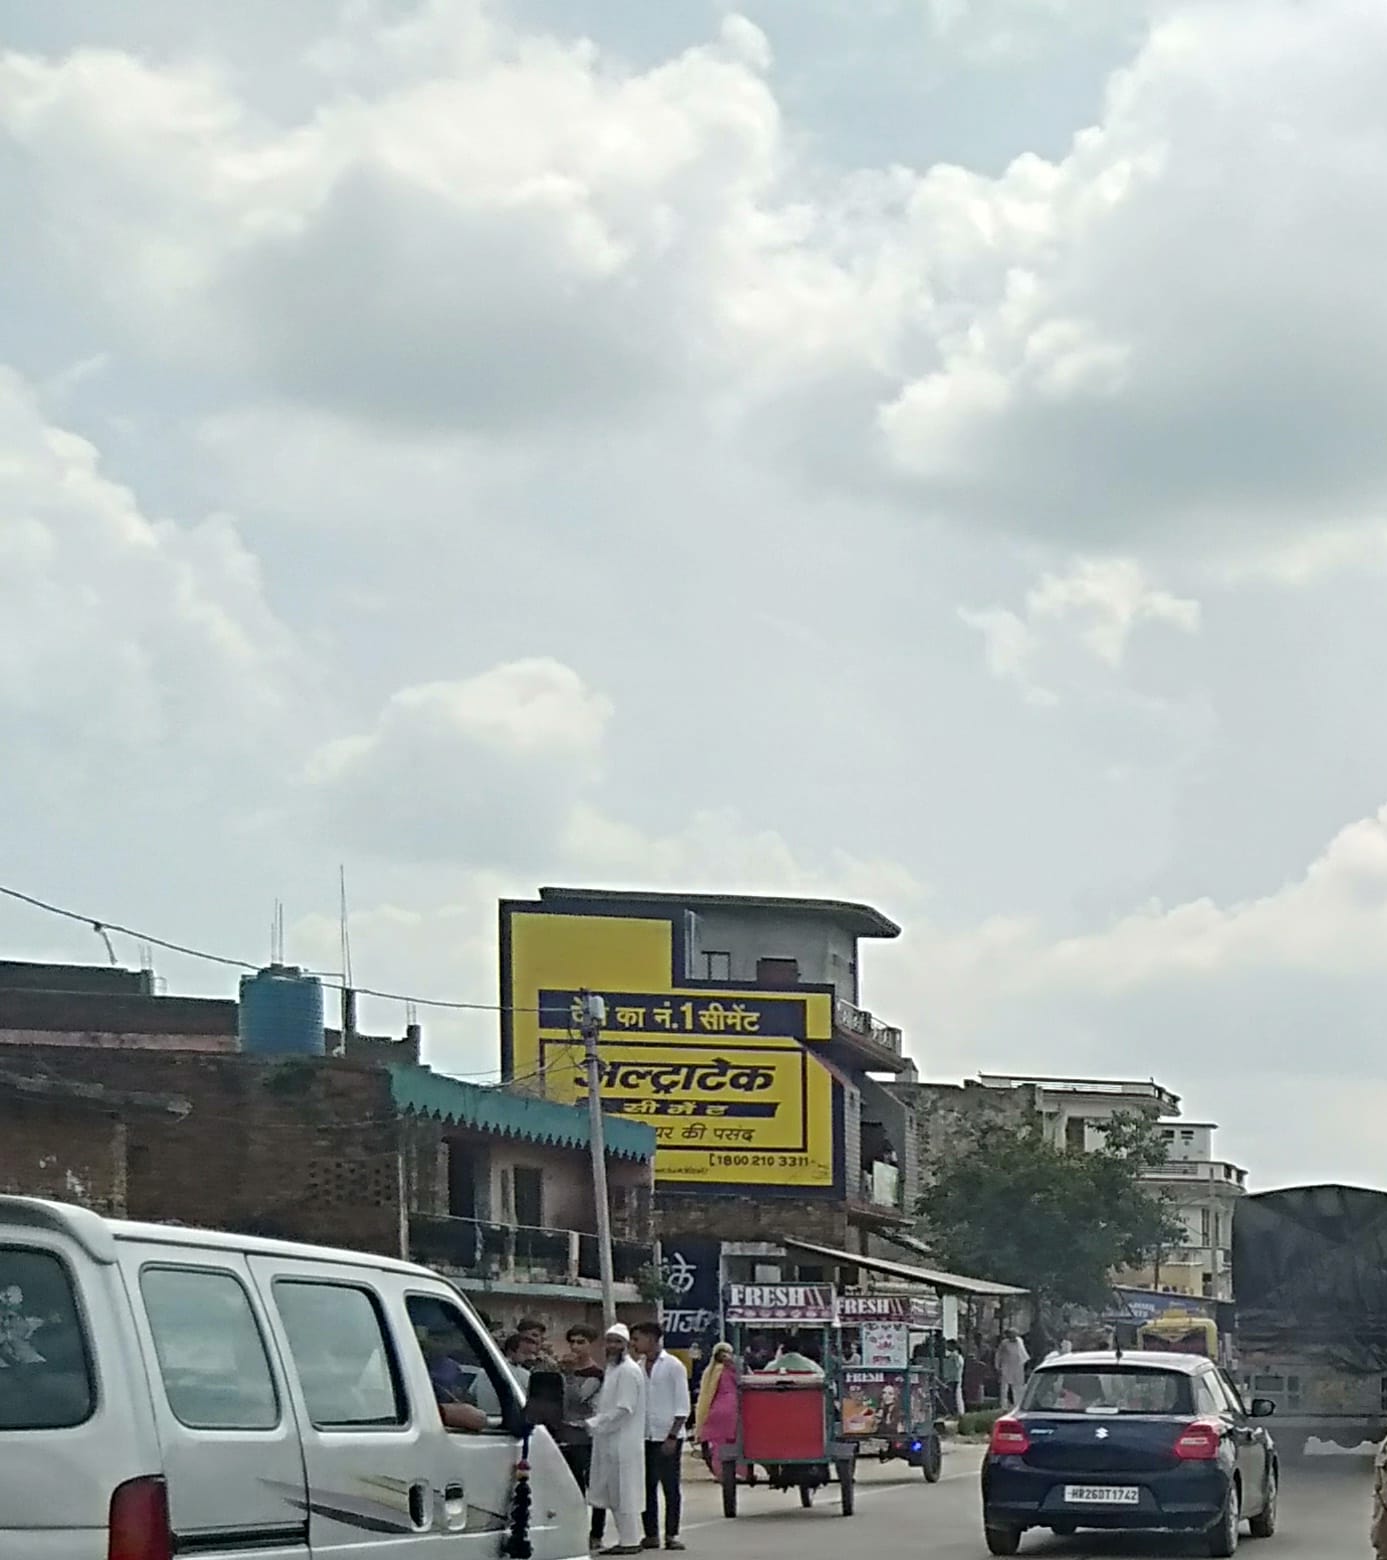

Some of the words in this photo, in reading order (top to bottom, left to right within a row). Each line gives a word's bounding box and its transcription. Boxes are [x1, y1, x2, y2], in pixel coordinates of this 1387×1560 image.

[615, 1006, 646, 1028] का
[698, 1002, 761, 1032] सीमेंट
[574, 1057, 777, 1095] अल्ट्राटेक
[681, 1122, 706, 1140] की
[713, 1124, 756, 1142] पसंद
[751, 1156, 775, 1167] 210
[730, 1284, 804, 1307] FRESH
[837, 1298, 890, 1315] FRESH
